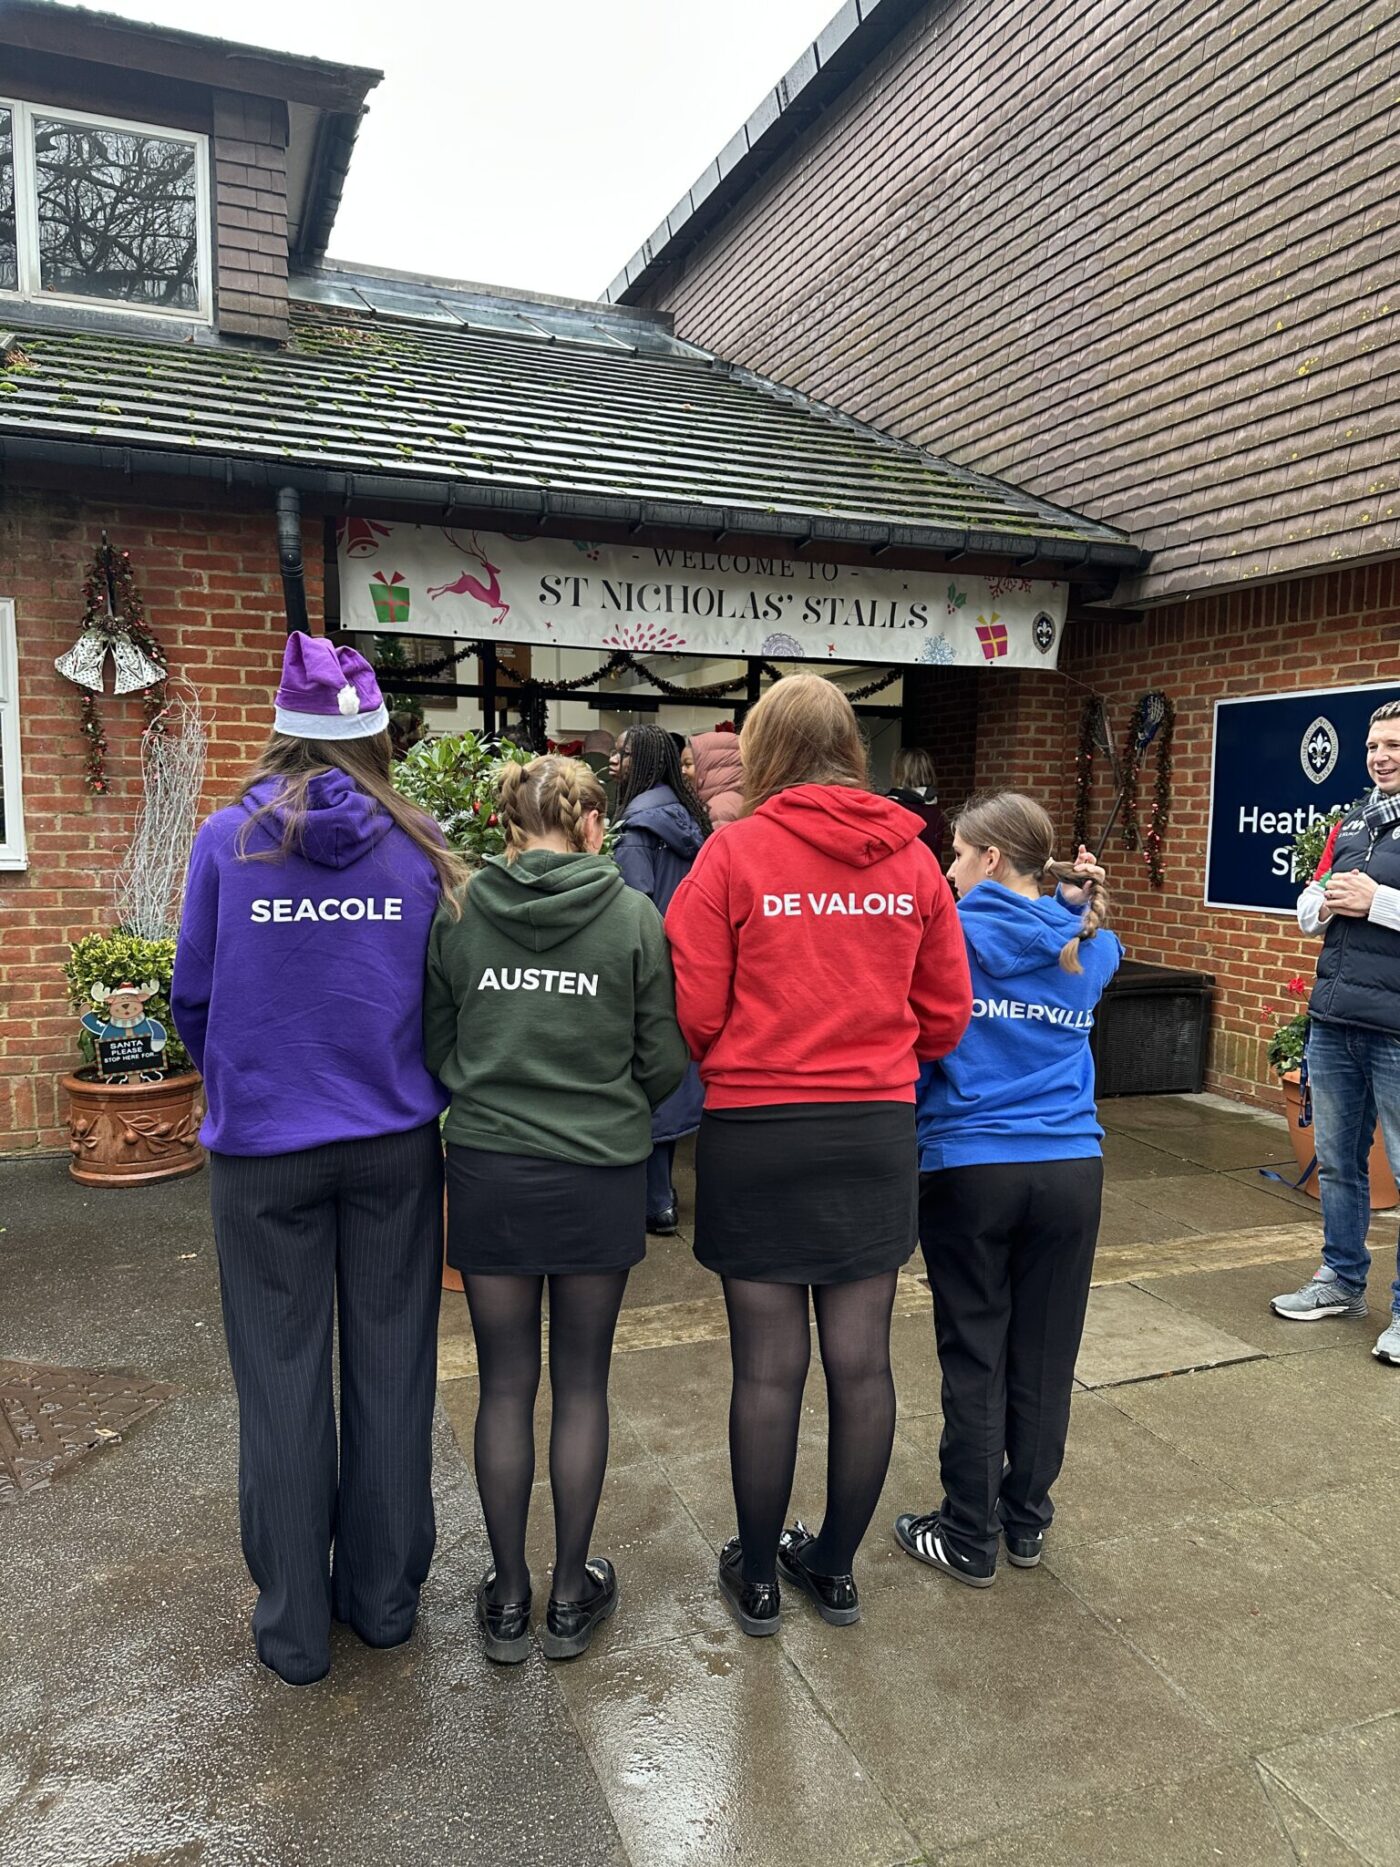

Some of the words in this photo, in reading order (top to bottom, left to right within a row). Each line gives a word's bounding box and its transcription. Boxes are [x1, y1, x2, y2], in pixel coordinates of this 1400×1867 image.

[653, 548, 794, 577] WELCOME
[804, 561, 839, 582] TO
[539, 574, 589, 607] ST
[802, 595, 928, 629] STALLS
[250, 897, 403, 923] SEACOLE
[763, 893, 802, 917] DE
[807, 892, 914, 917] VALOIS
[477, 967, 599, 997] AUSTEN
[971, 998, 1094, 1028] OMERVILLE
[110, 1040, 144, 1049] SANTA
[111, 1047, 143, 1056] PLEASE
